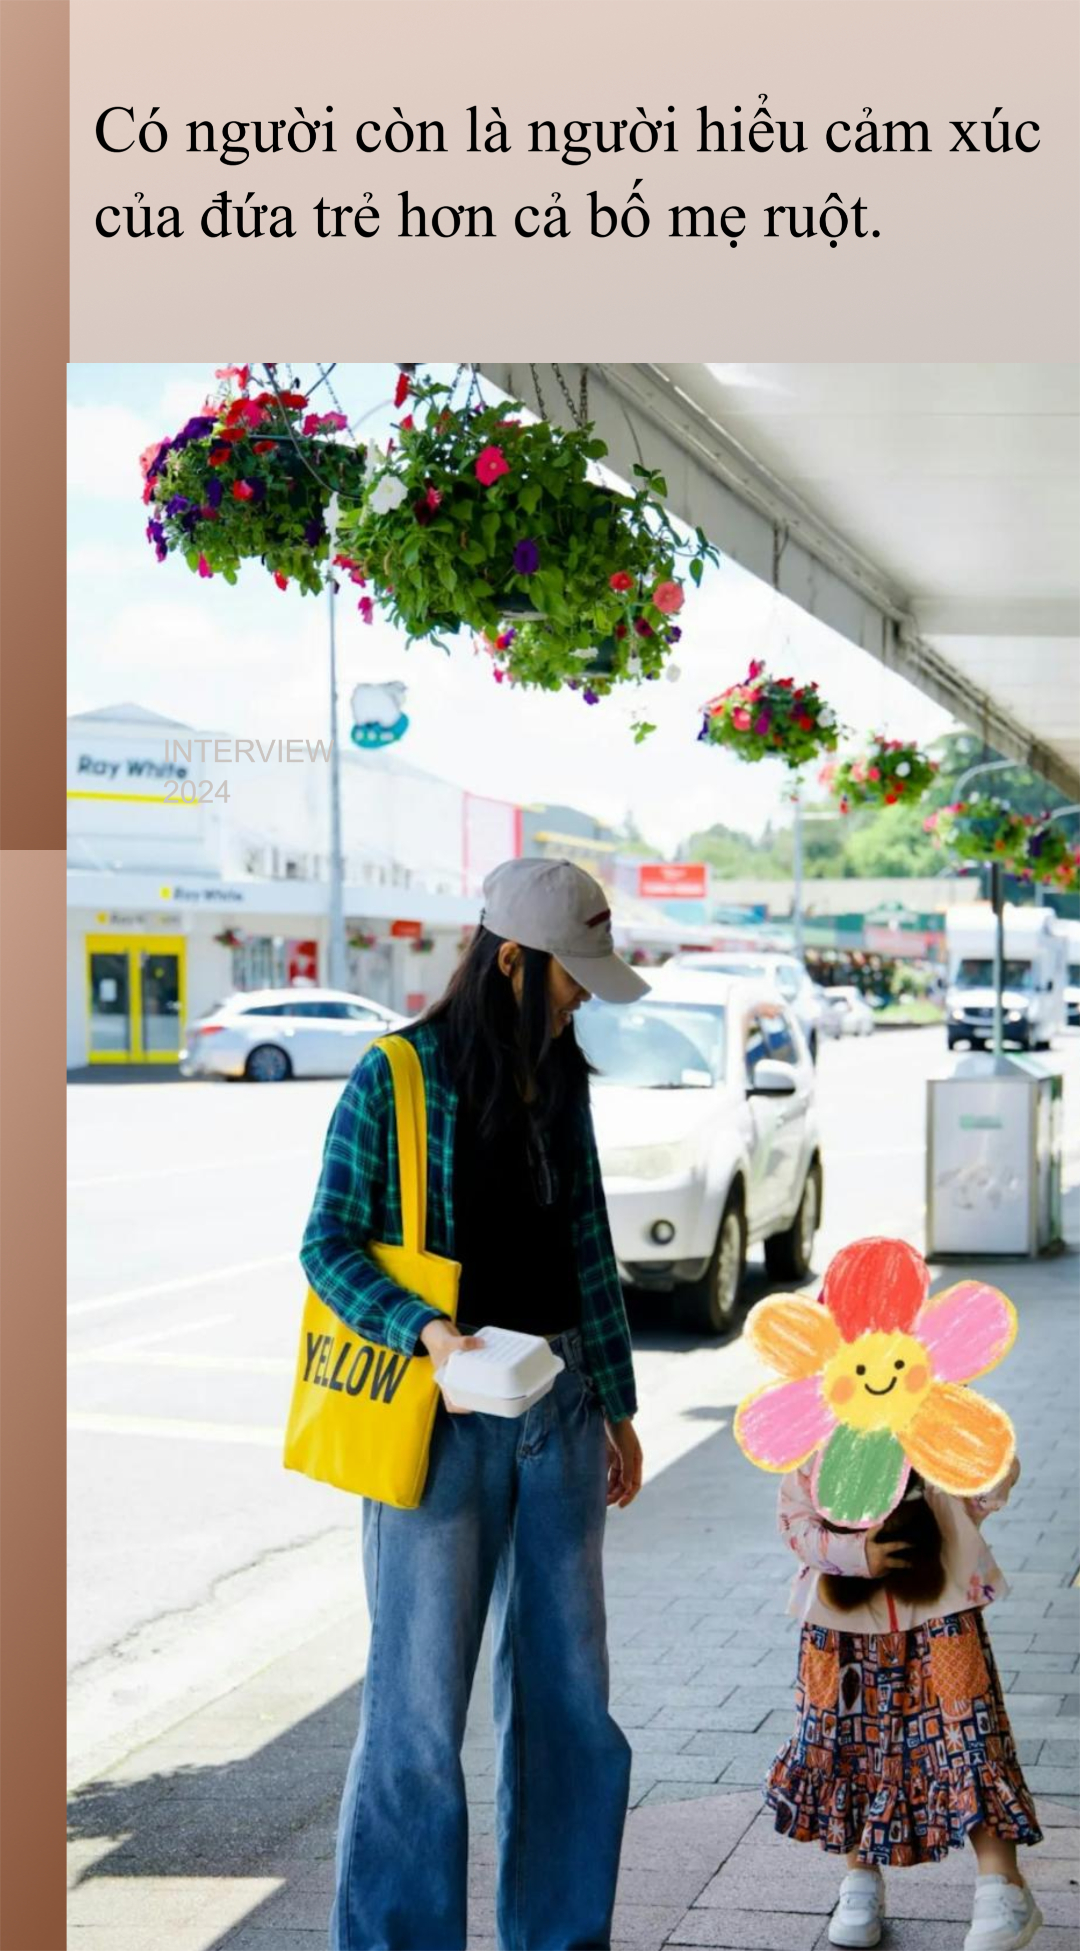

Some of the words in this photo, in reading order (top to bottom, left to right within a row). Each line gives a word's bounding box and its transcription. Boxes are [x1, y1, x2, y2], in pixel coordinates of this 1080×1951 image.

[78, 754, 119, 780] Ray
[126, 757, 188, 780] White
[302, 1331, 412, 1405] YELLOW
